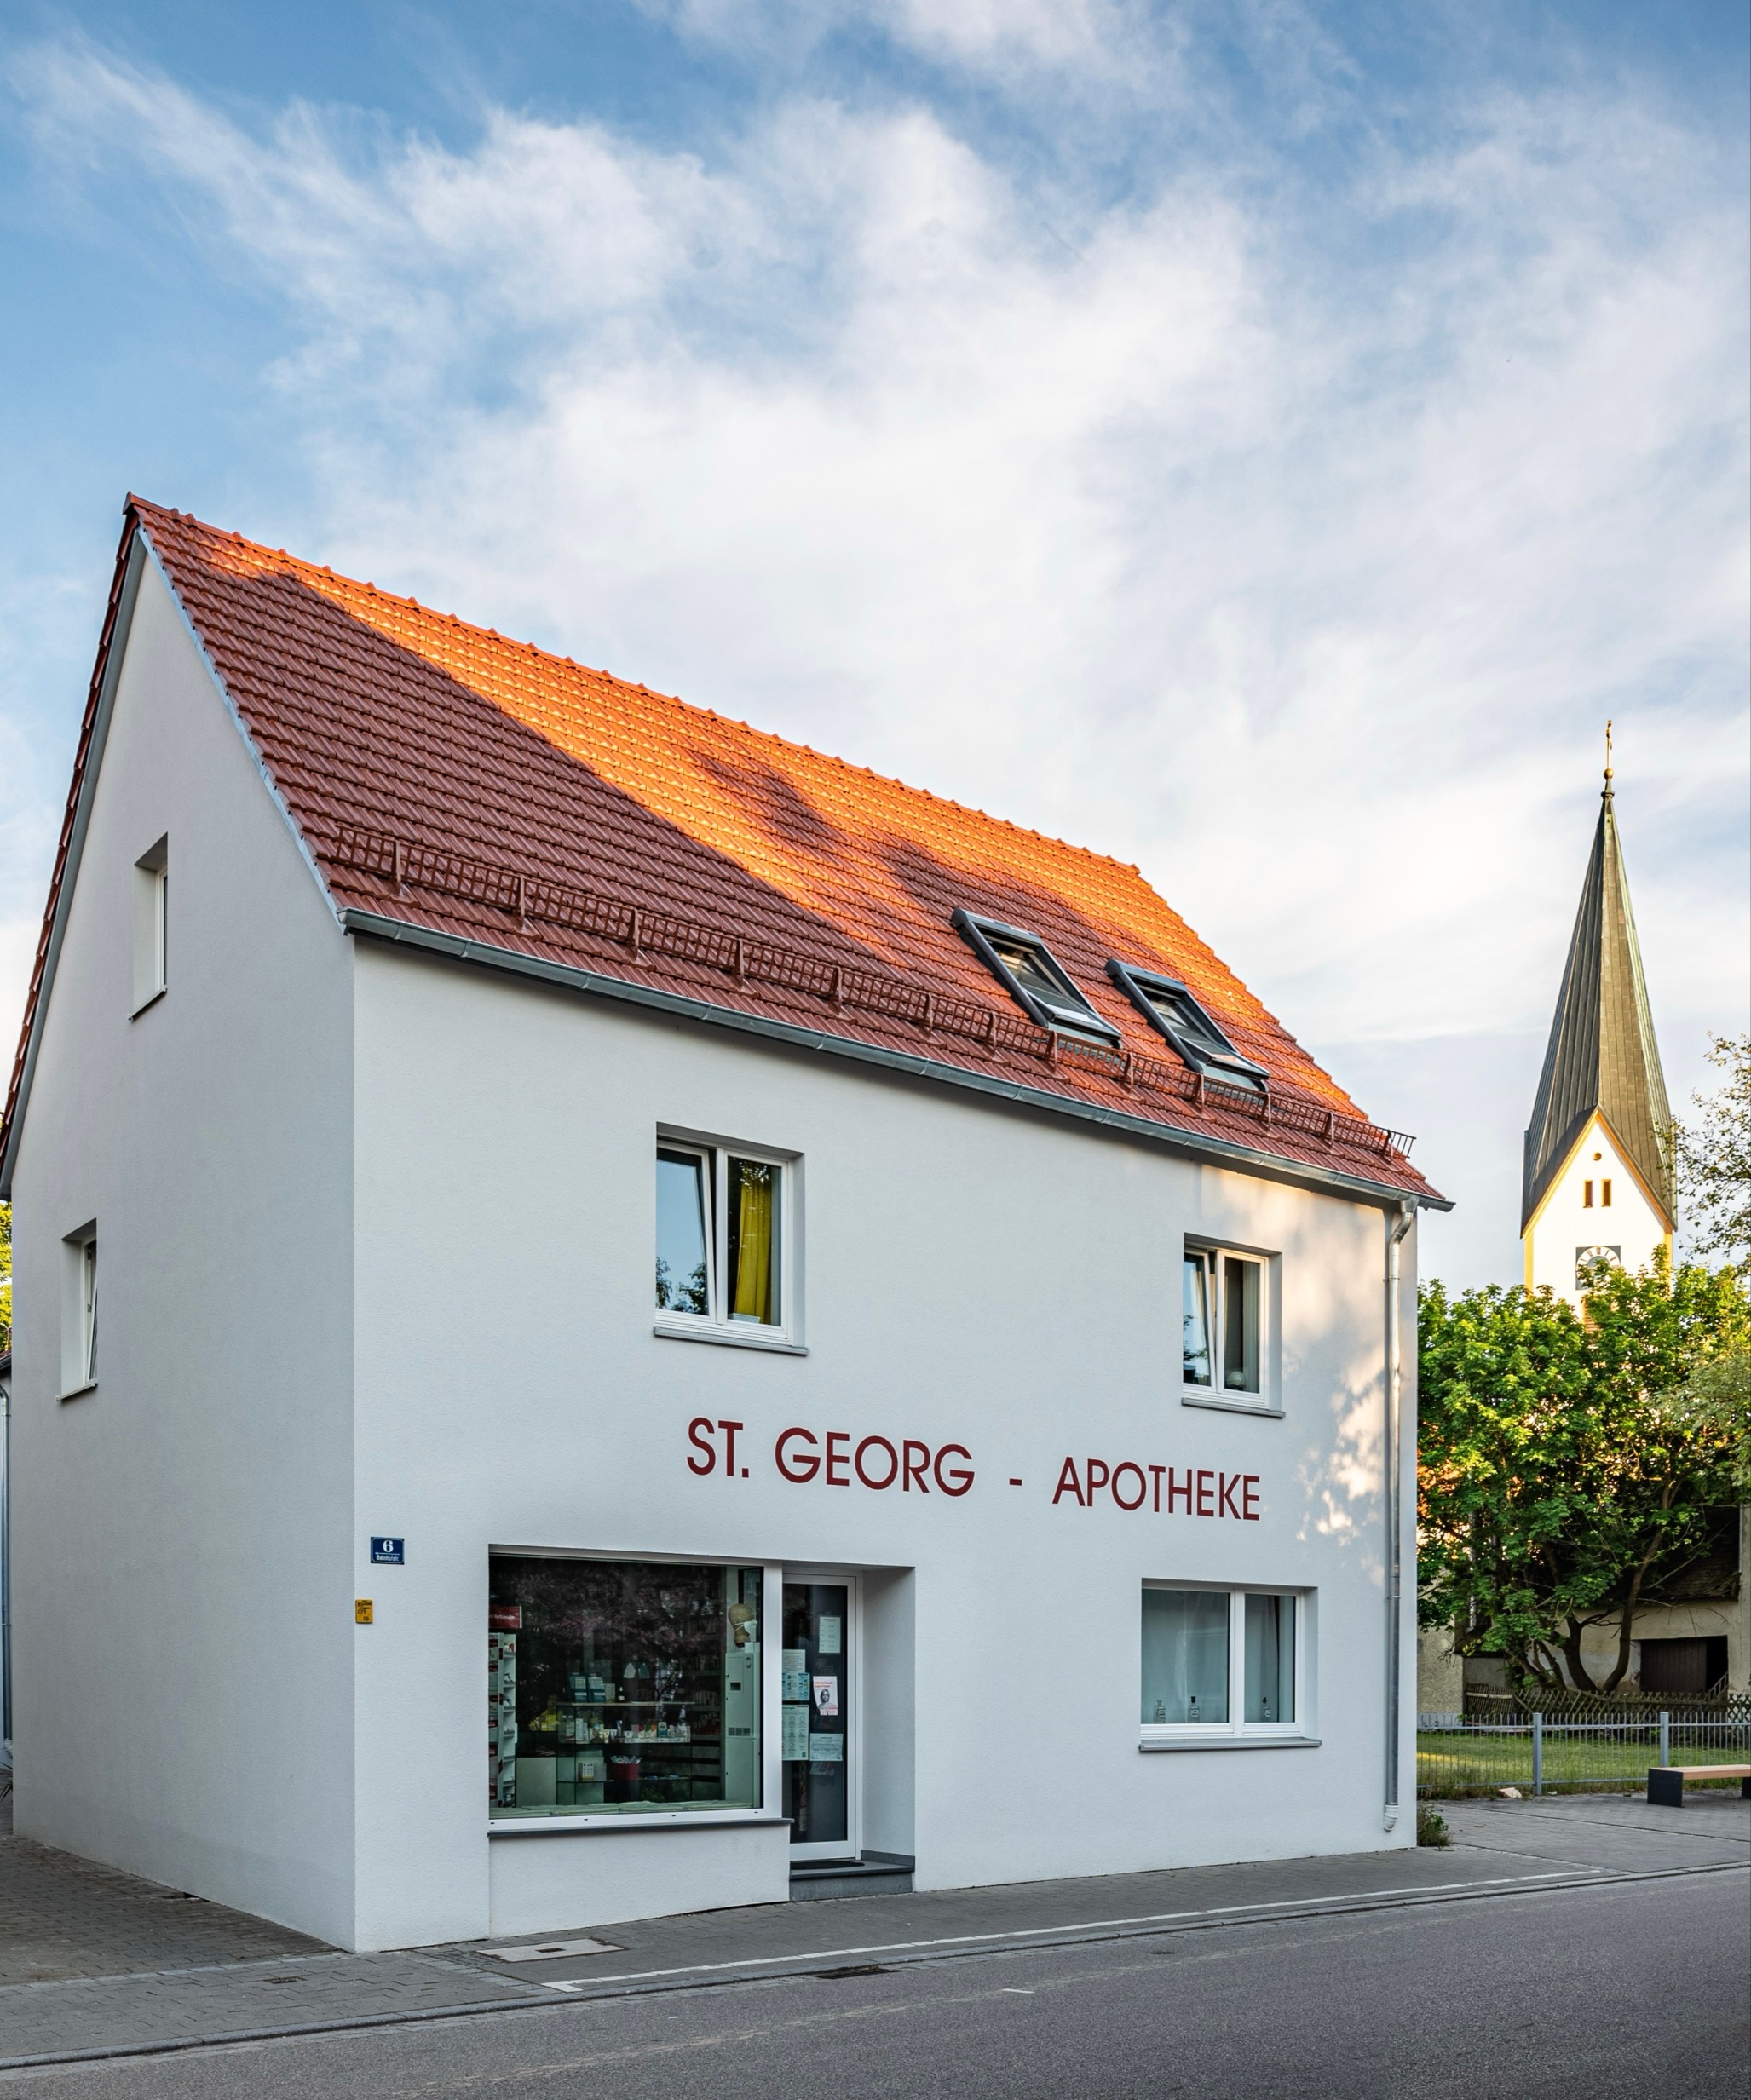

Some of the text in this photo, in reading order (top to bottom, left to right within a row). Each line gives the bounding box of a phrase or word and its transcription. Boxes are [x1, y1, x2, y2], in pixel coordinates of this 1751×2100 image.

[687, 1417, 749, 1477] ST.
[775, 1427, 974, 1496] GEORG
[1052, 1457, 1259, 1521] APOTHEKE
[383, 1540, 394, 1553] 6
